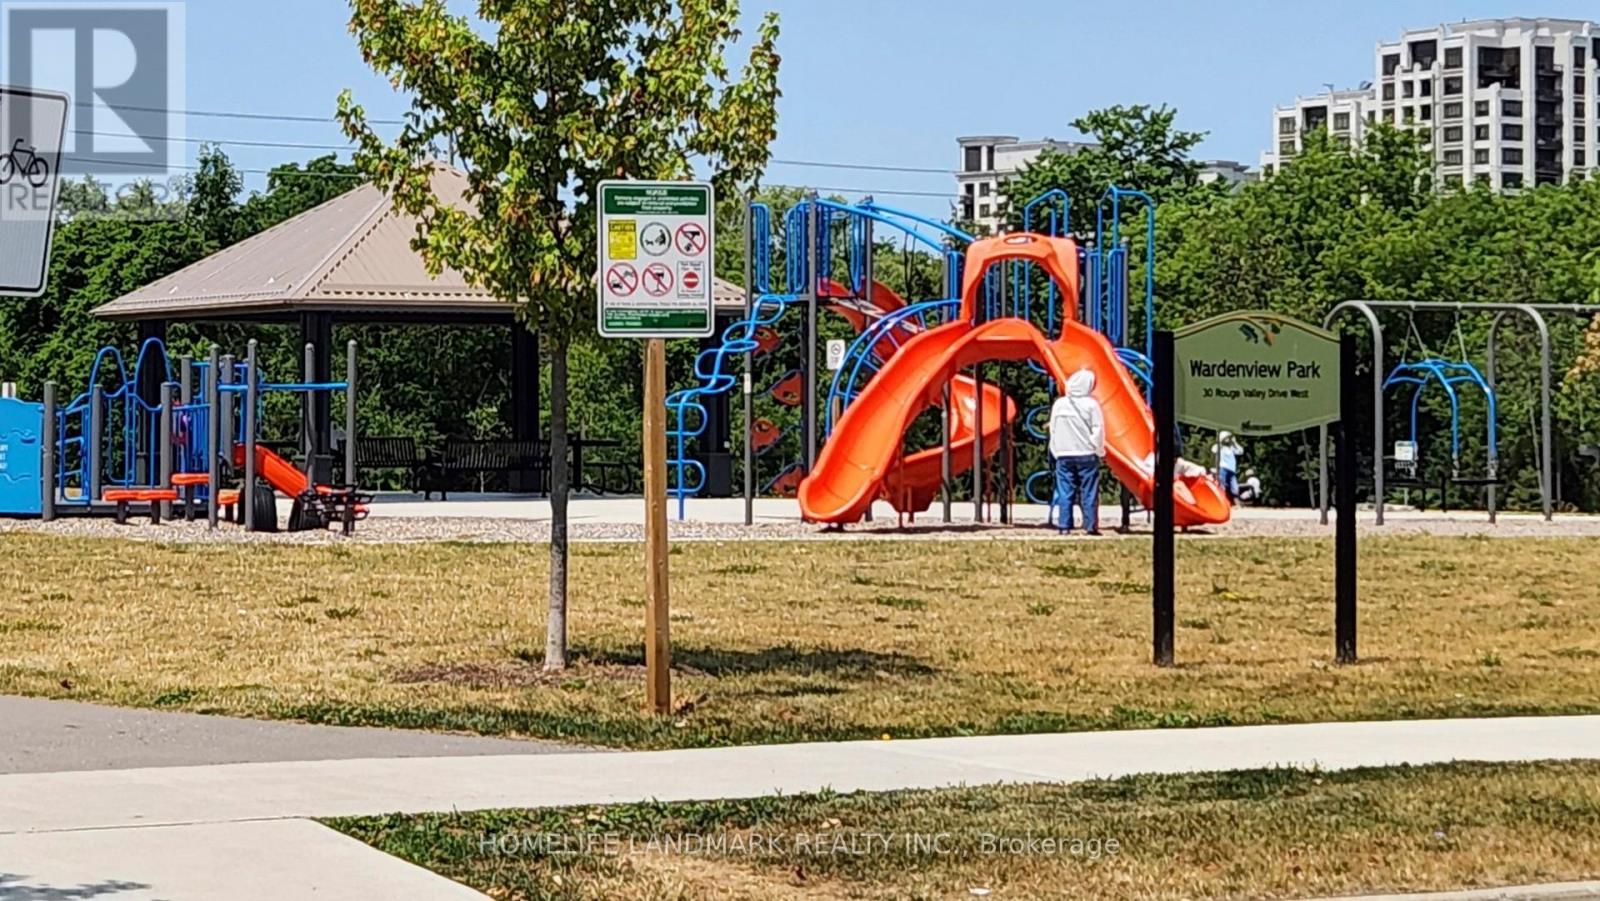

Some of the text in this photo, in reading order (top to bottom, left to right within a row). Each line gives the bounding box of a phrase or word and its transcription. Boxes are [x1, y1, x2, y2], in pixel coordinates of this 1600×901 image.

[1190, 360, 1321, 379] Wardenview Park
[1203, 388, 1309, 400] 30 Rouge Valley Drive West
